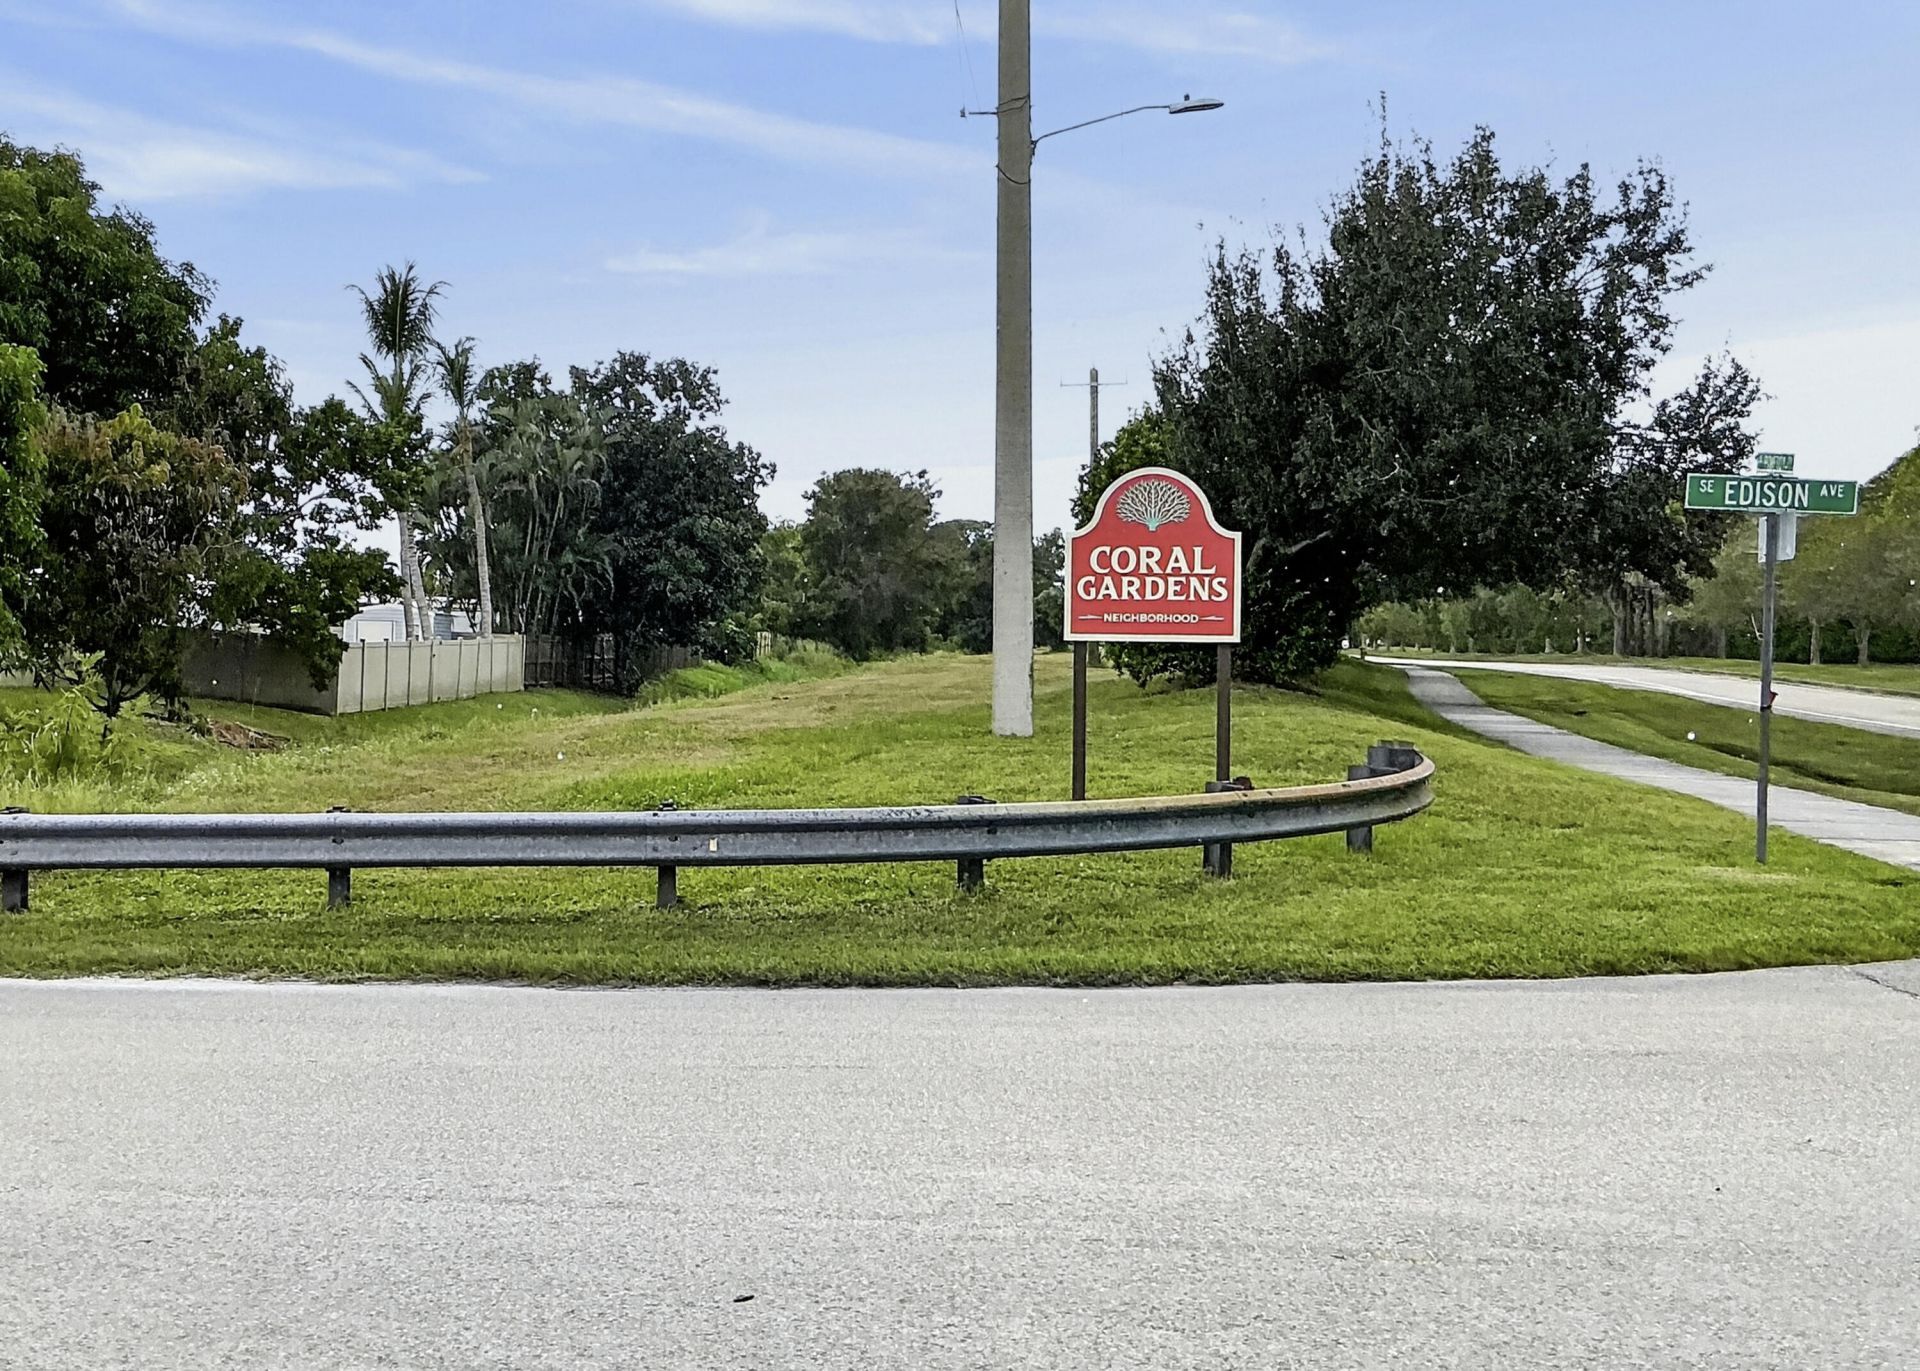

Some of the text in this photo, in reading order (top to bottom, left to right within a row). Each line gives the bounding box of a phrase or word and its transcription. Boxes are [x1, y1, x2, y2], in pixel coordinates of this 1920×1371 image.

[1699, 480, 1845, 508] SE EDISON AVE
[1090, 546, 1217, 574] CORAL
[1076, 576, 1229, 601] GARDENS
[1103, 612, 1199, 623] NEIGHBORHOOD
